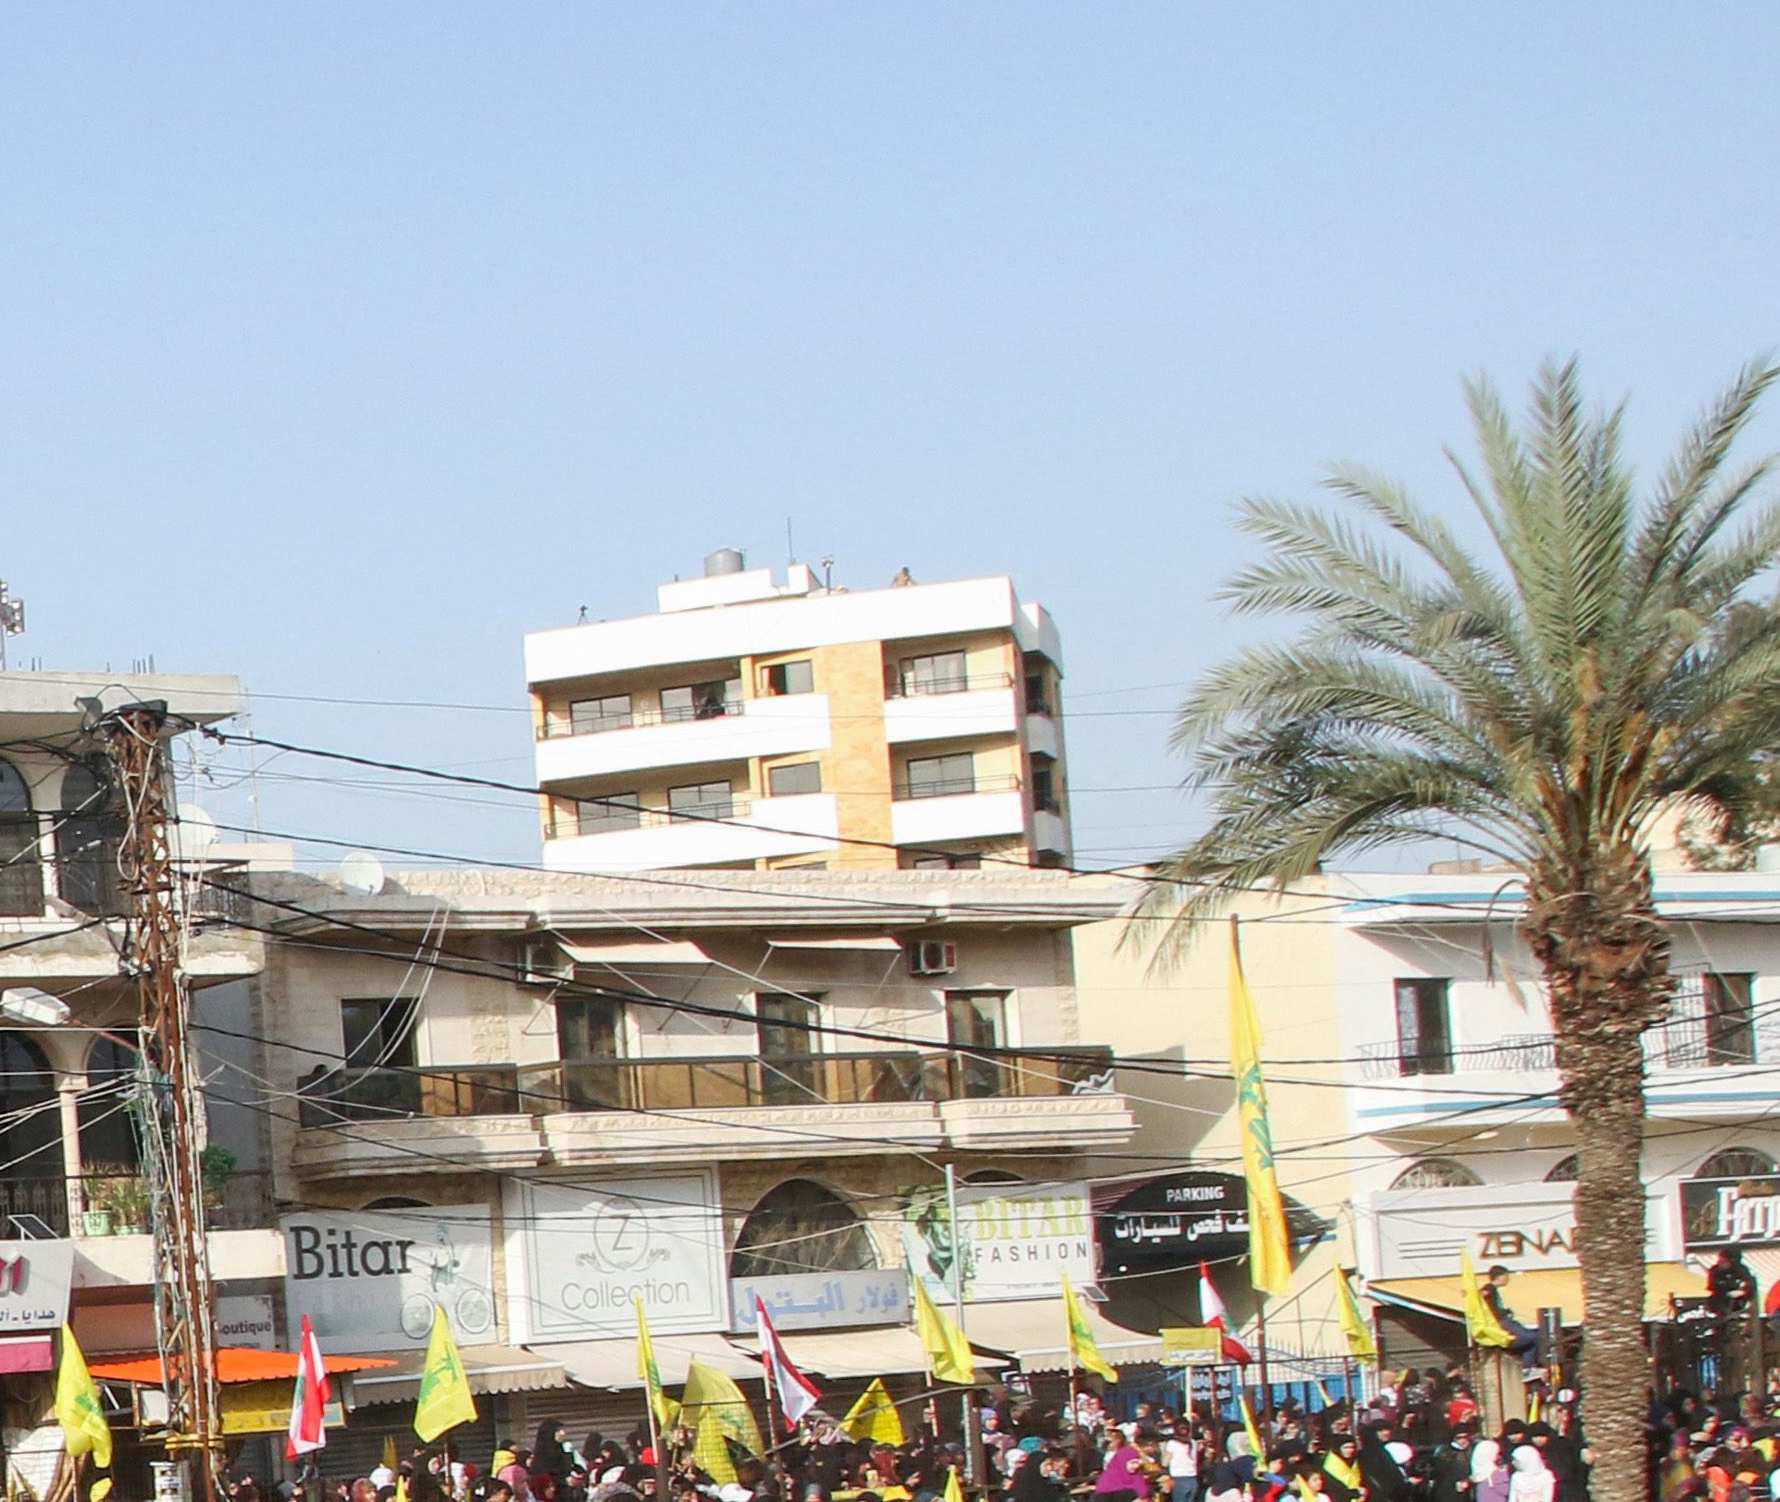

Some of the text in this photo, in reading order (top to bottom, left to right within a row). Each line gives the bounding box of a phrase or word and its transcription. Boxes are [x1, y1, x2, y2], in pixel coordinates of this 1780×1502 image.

[1166, 1186, 1224, 1202] PARKING
[610, 1213, 633, 1251] Z
[974, 1198, 1086, 1240] BITAR
[1114, 1213, 1181, 1243] للسيارات
[1187, 1208, 1224, 1241] فحص
[290, 1225, 415, 1280] Bitar
[975, 1240, 1090, 1264] FASHION
[561, 1279, 690, 1310] Collection
[21, 1309, 56, 1325] هدايا
[219, 1320, 272, 1335] outique
